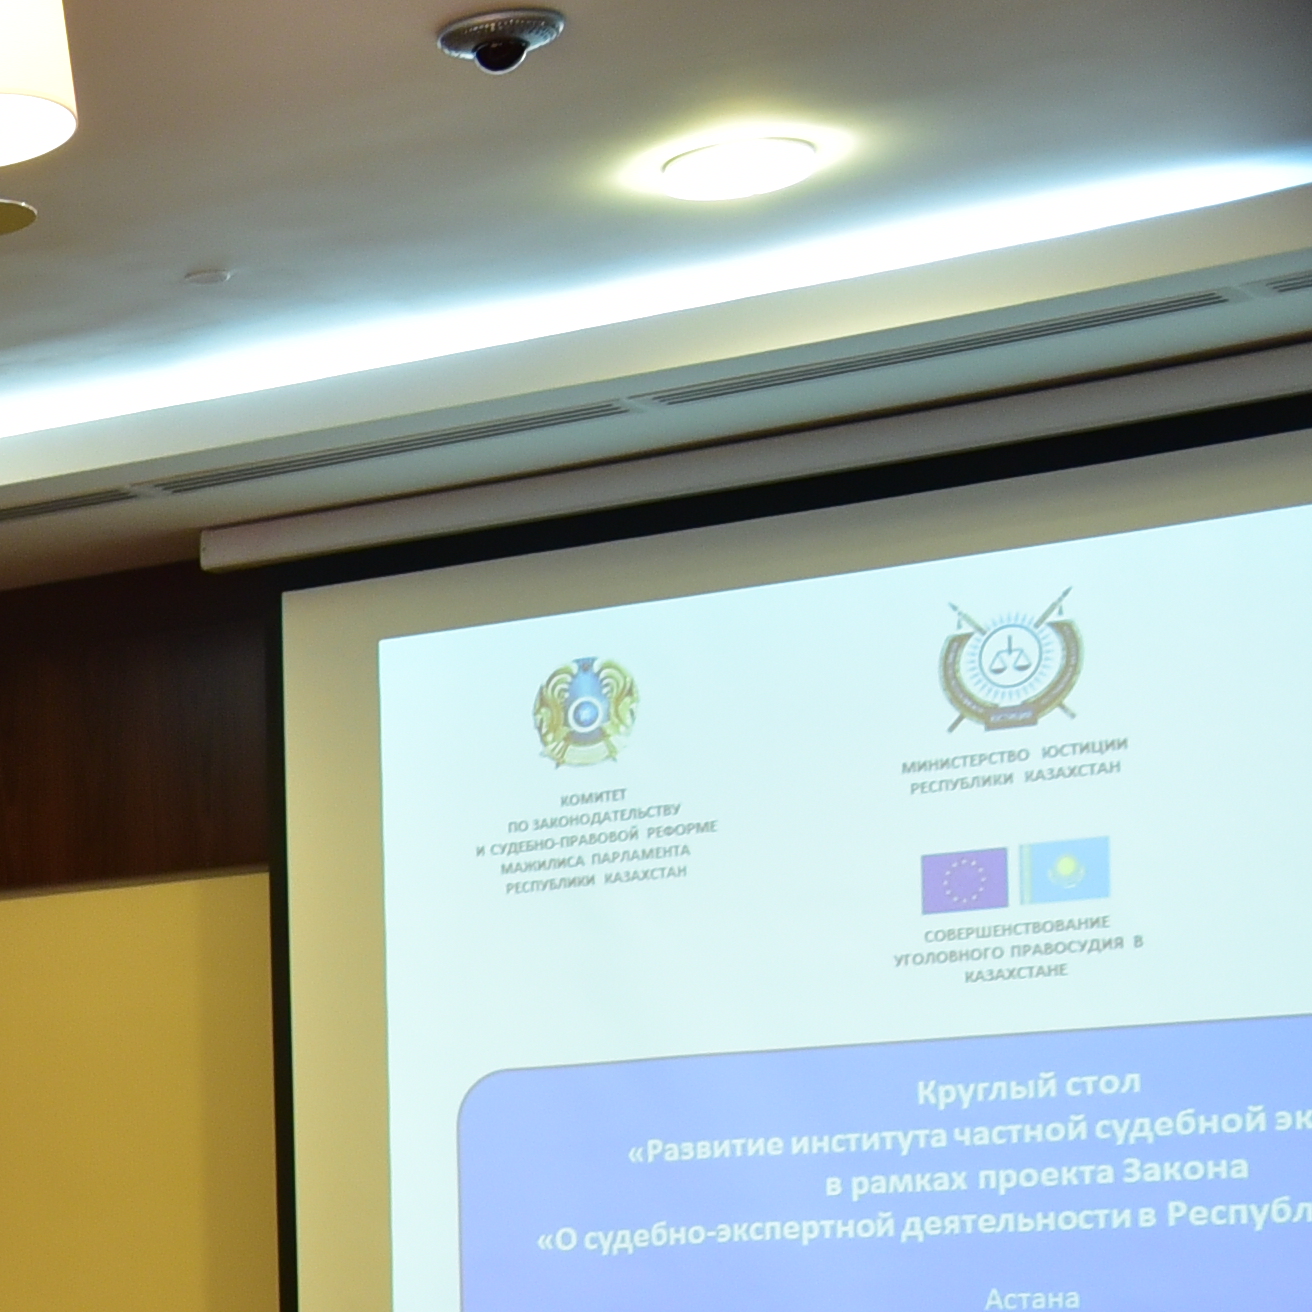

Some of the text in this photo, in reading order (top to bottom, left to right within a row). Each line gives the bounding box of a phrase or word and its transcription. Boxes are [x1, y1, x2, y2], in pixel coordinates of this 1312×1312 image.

[901, 737, 1129, 774] МИНИСТЕРСТВО ЮСТИЦИИ
[910, 761, 1121, 795] РЕСПУБЛИКИ КАЗАХСТАН
[560, 788, 627, 807] КОМИТЕТ
[508, 803, 681, 833] ПО ЗАКОНОДАТЕЛЬСТВУ
[476, 820, 718, 857] И СУДЕБНО-ПРАВОВОЙ РЕФОРМЕ
[501, 844, 691, 875] МАЖИЛИСА ПАРЛАМЕНТА
[506, 866, 687, 894] РЕСПУБЛИКИ КАЗАХСТАН
[924, 915, 1111, 943] СОВЕРШЕНСТВОВАНИЕ
[894, 935, 1144, 967] УГОЛОВНОГО ПРАВОСУДИЯ В
[964, 963, 1069, 983] КАЗАХСТАНЕ
[917, 1071, 1141, 1109] Круглый стол
[628, 1132, 784, 1163] «Развитие
[791, 1126, 947, 1156] института
[954, 1113, 1088, 1147] частной
[1096, 1105, 1267, 1145] судебной
[826, 1156, 1249, 1200] в рамках проекта Закона
[537, 1226, 577, 1251] «О
[584, 1212, 895, 1256] судебно-экспертной
[900, 1205, 1132, 1243] деятельности
[1138, 1206, 1157, 1228] в
[985, 1288, 1081, 1311] Астана
